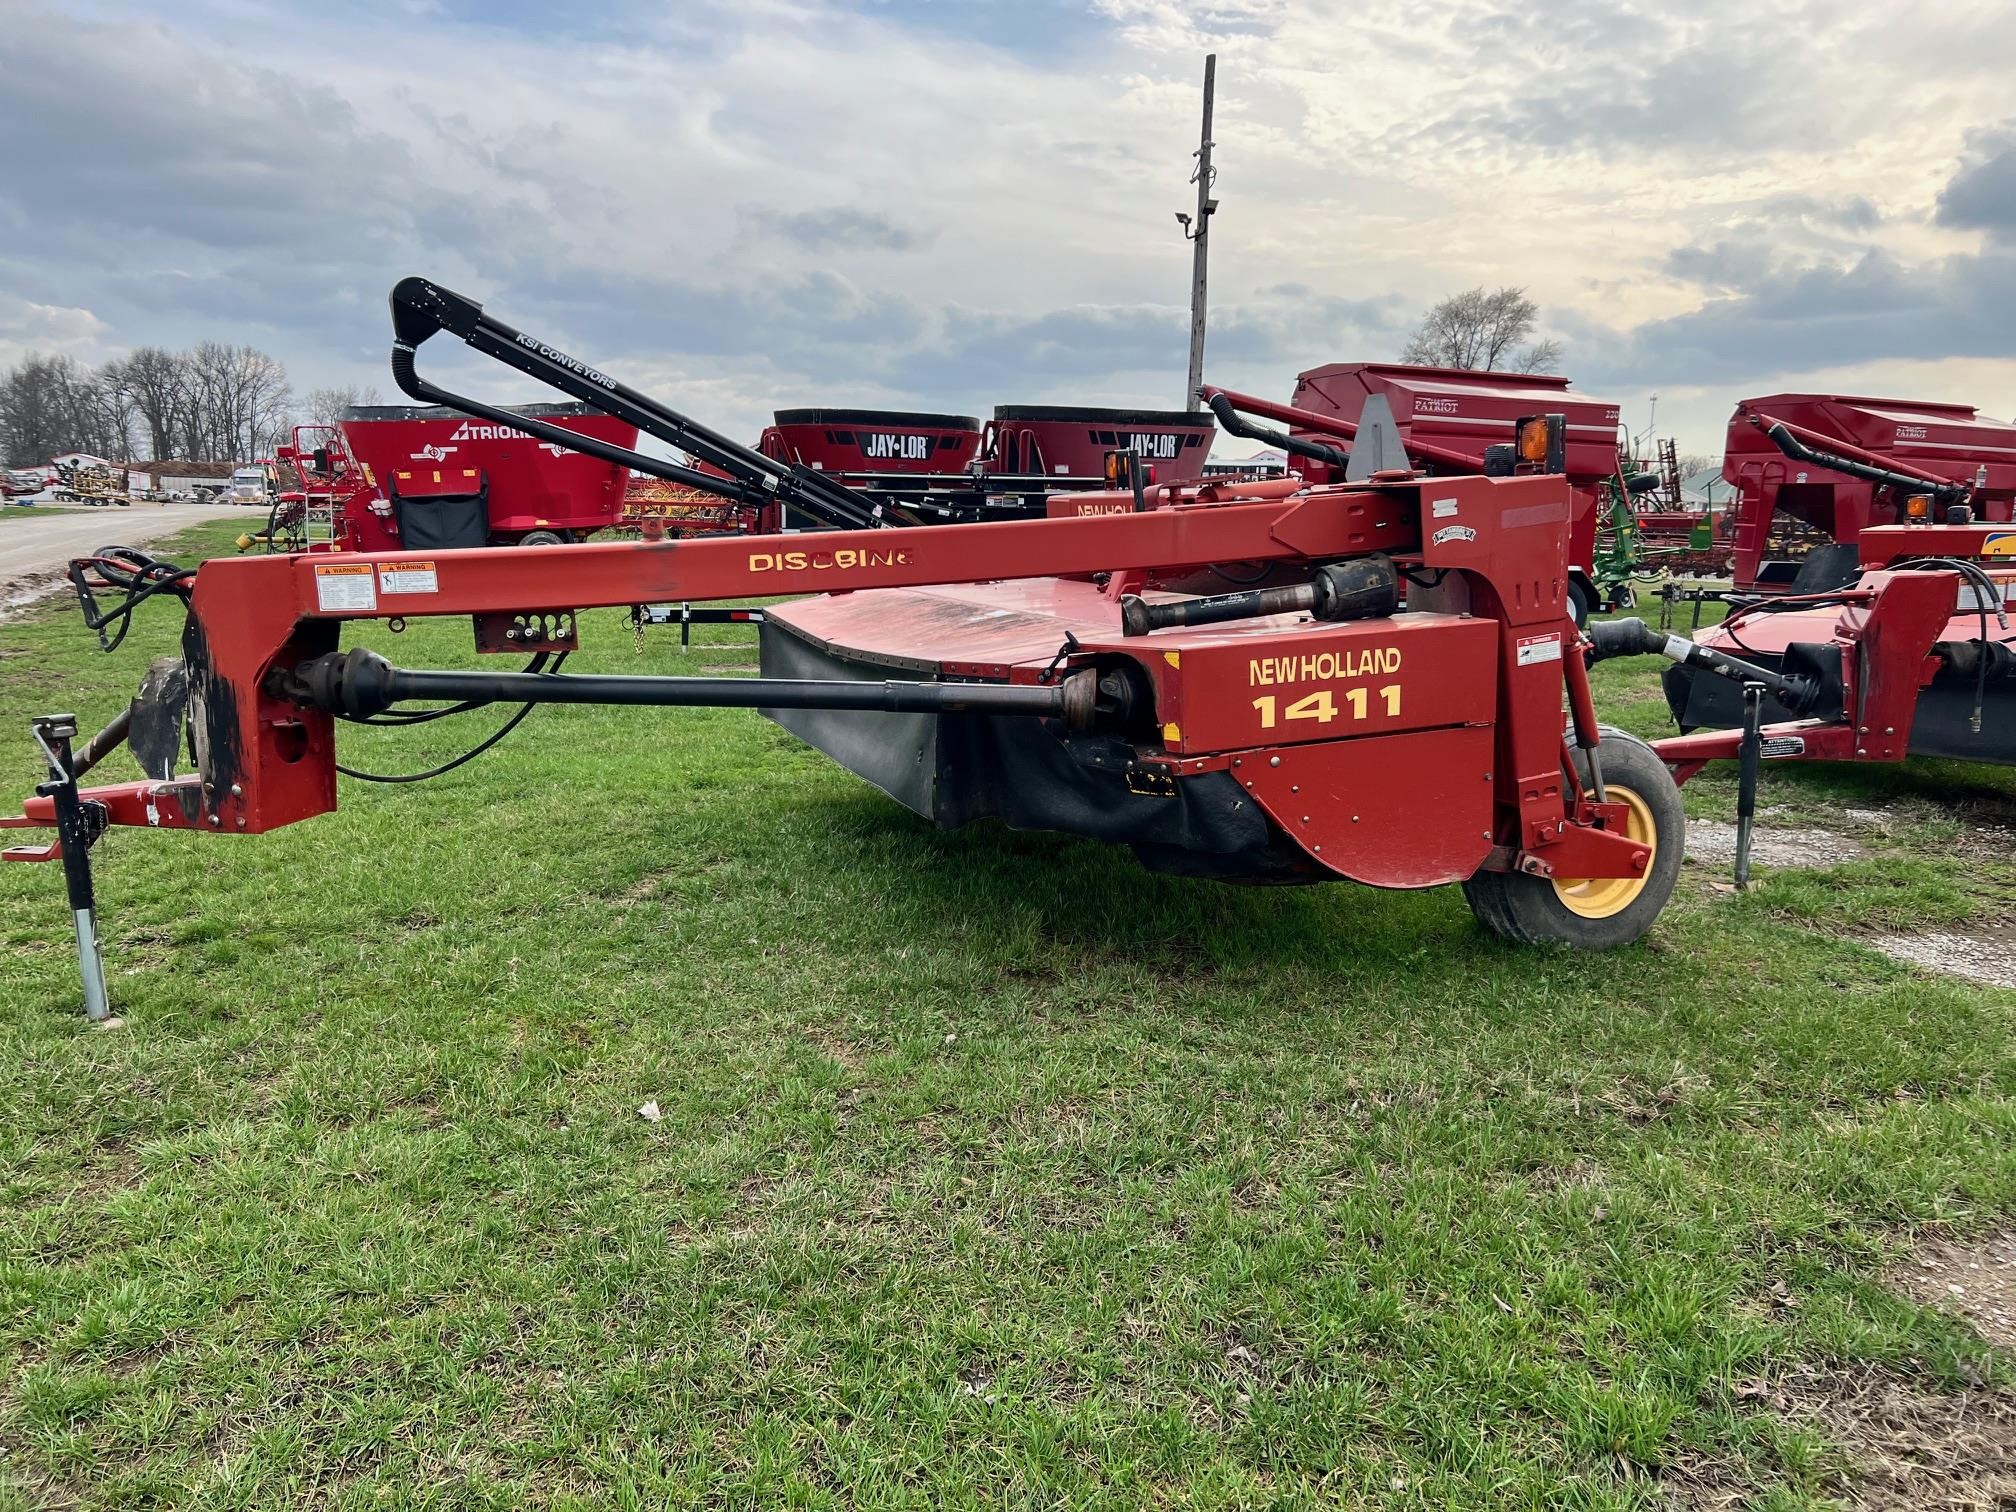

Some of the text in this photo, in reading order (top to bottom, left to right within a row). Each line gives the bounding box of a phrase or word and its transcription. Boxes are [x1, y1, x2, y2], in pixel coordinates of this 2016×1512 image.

[516, 333, 617, 390] KSI CONVEYORS
[1414, 400, 1459, 413] PATRIOT
[1896, 428, 1928, 438] PATRIOT
[1249, 647, 1402, 687] NEW HOLLAND
[1252, 685, 1401, 729] 1411
